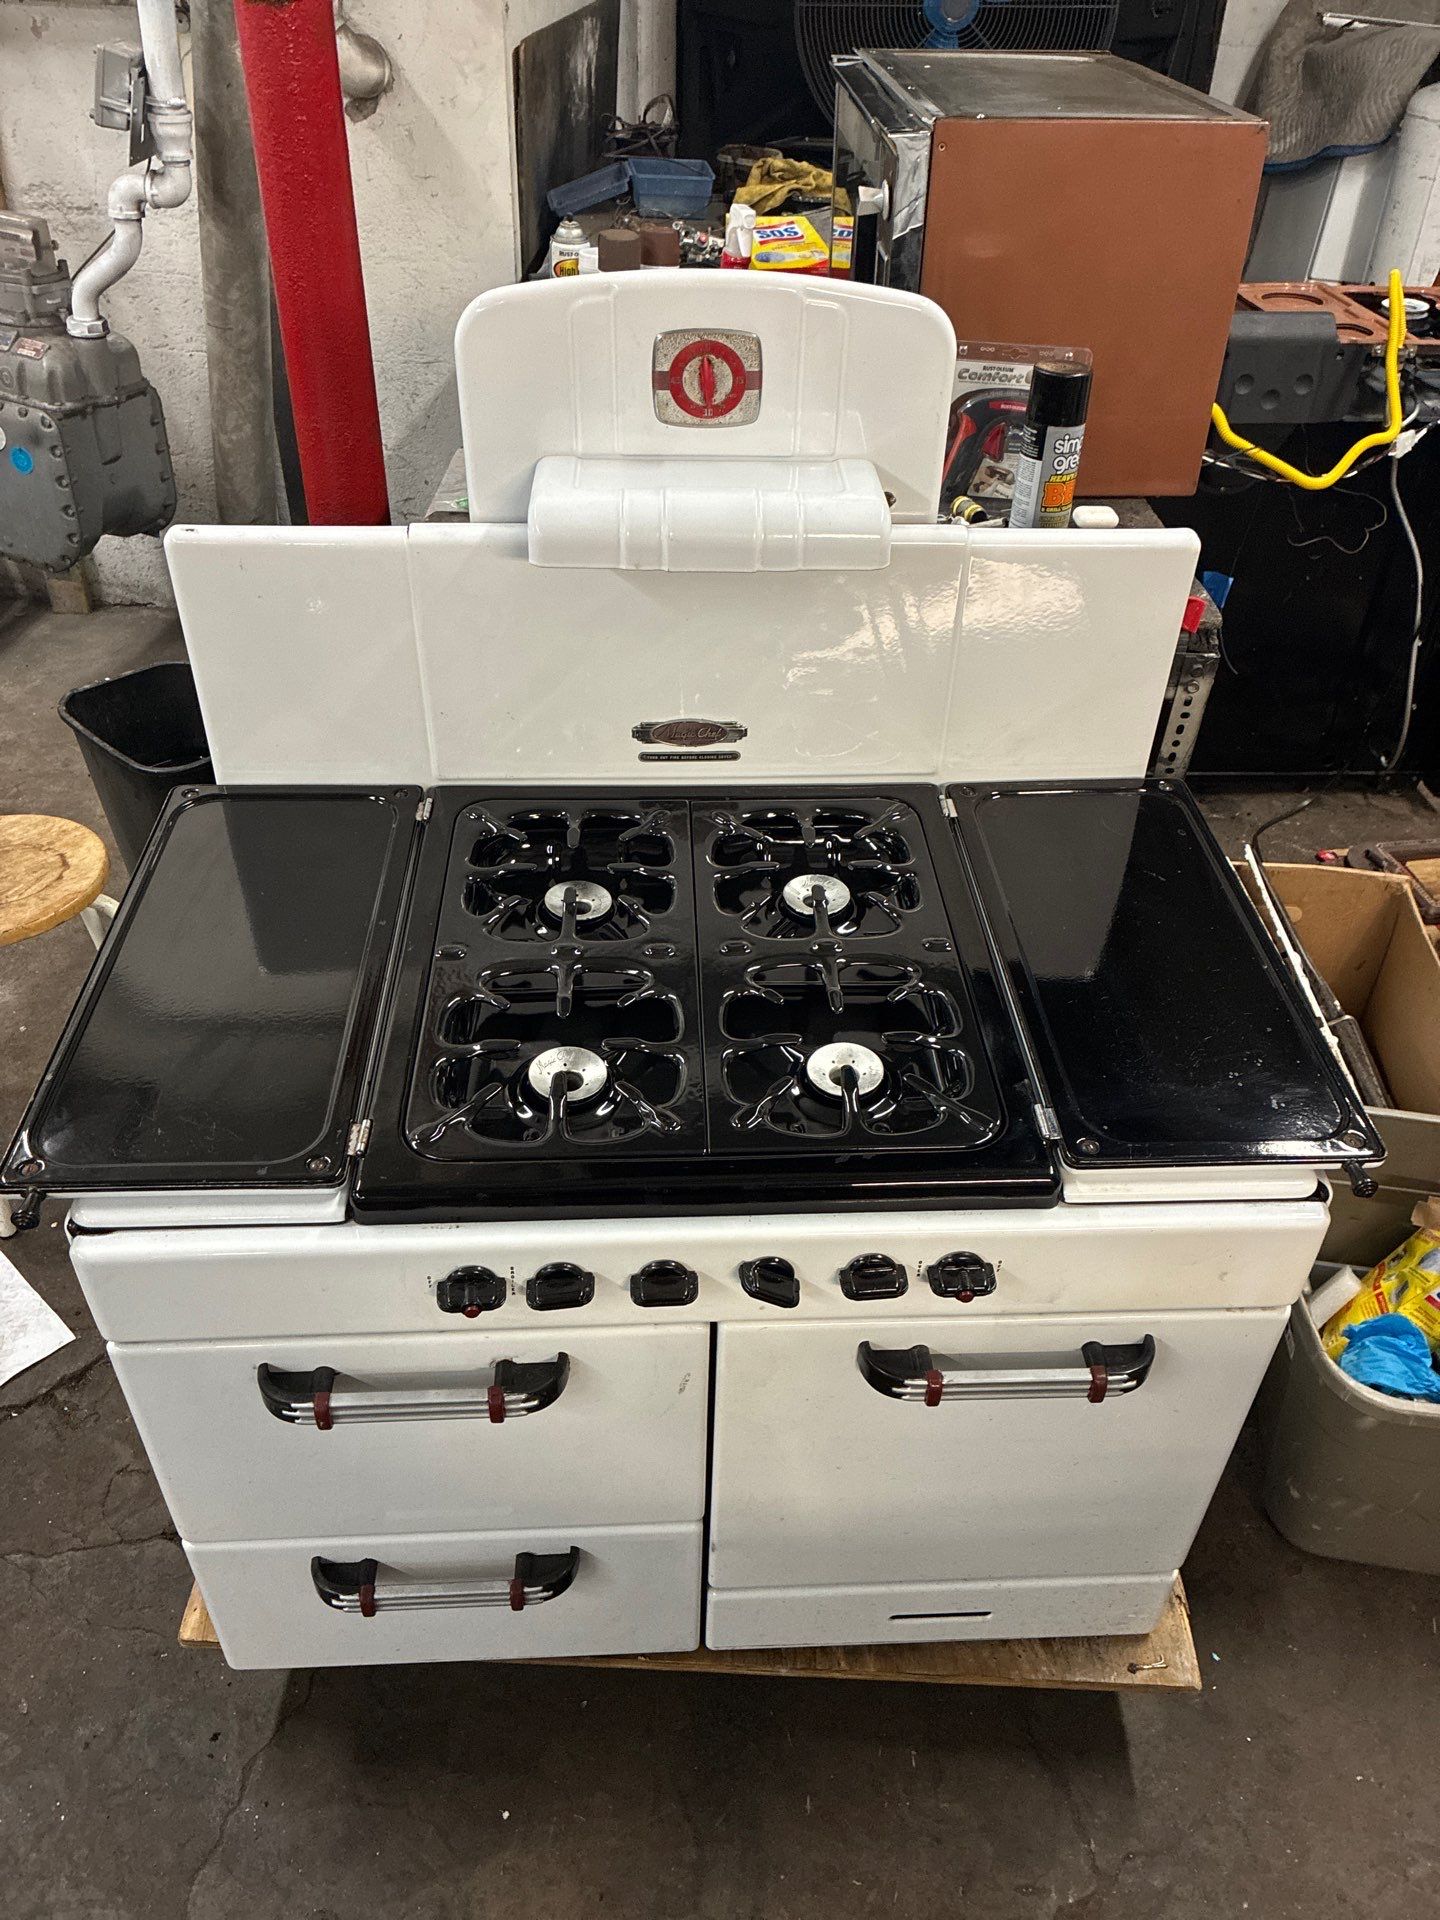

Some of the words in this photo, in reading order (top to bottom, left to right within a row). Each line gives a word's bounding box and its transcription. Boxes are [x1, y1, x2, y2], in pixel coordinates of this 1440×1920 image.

[755, 226, 800, 239] SOS
[957, 368, 1024, 383] Comfort
[697, 727, 723, 740] Chef
